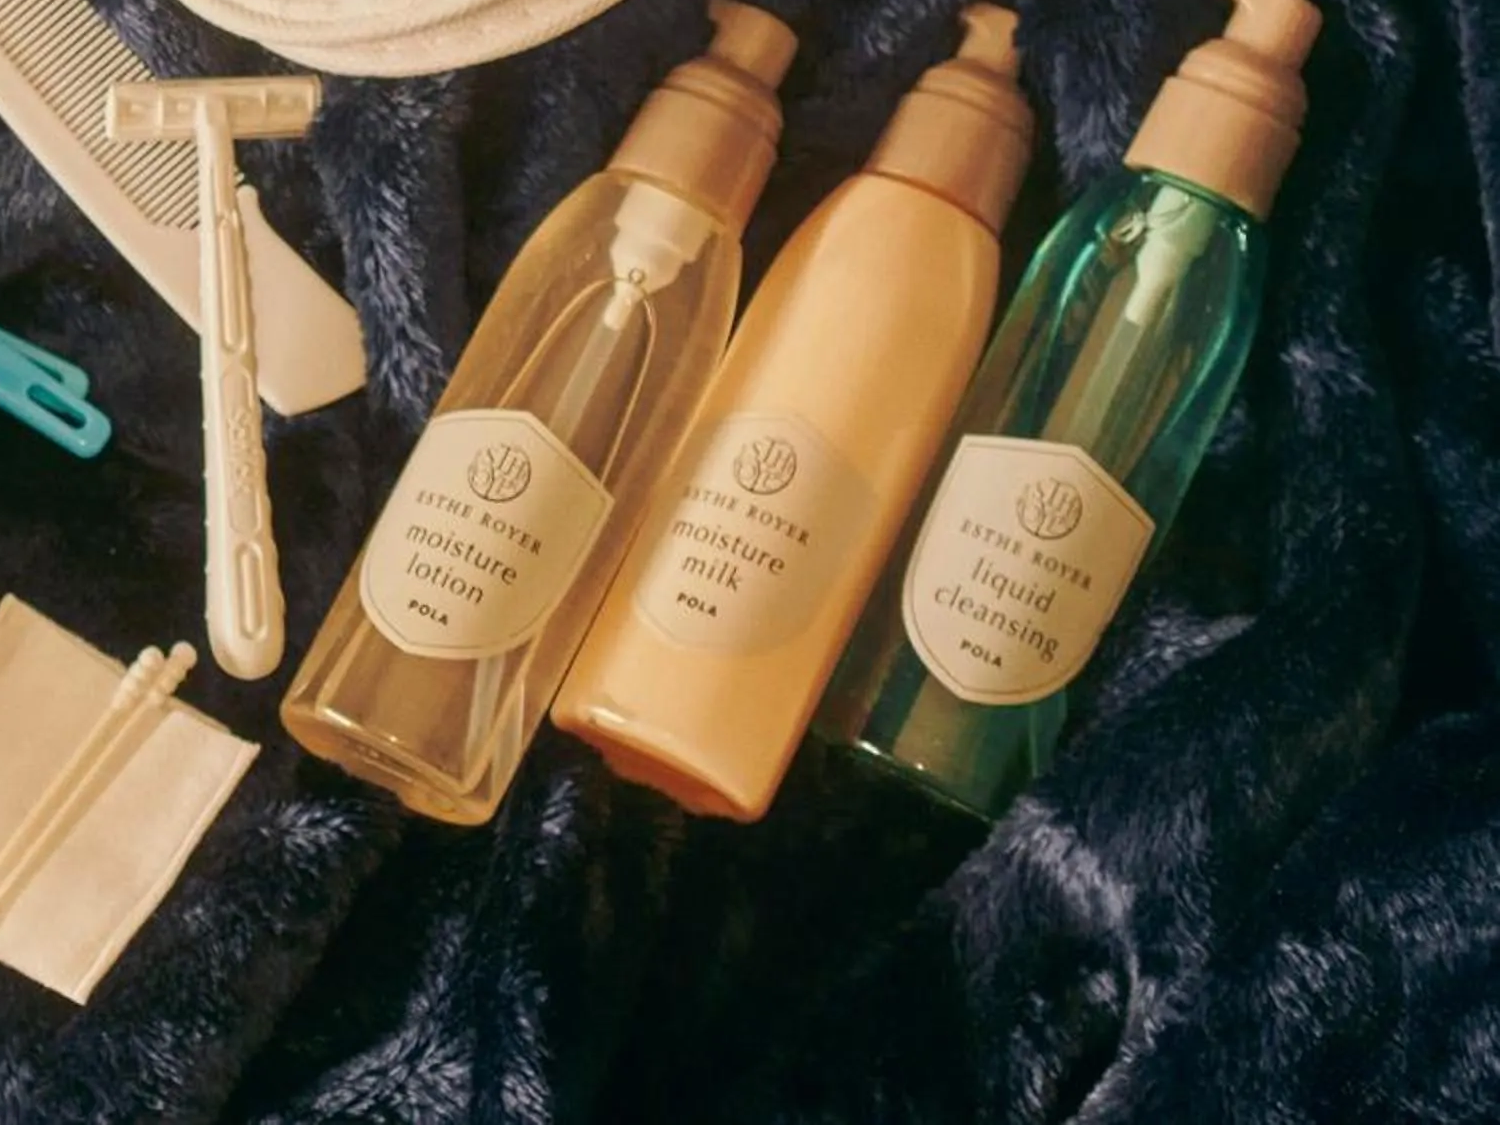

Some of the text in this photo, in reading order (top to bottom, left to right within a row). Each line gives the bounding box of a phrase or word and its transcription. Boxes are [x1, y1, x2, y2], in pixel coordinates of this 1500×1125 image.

[480, 512, 542, 556] ROYER
[672, 519, 785, 576] moisture
[746, 503, 810, 547] ROYER
[406, 524, 517, 586] moisture
[406, 552, 485, 605] lotion
[681, 555, 743, 593] milk
[960, 518, 1093, 591] ESTHE ROYER
[676, 591, 718, 617] POLA
[972, 557, 1056, 614] liquid
[408, 599, 449, 626] POLA
[934, 584, 1060, 664] cleansing
[960, 638, 1002, 668] POLA
